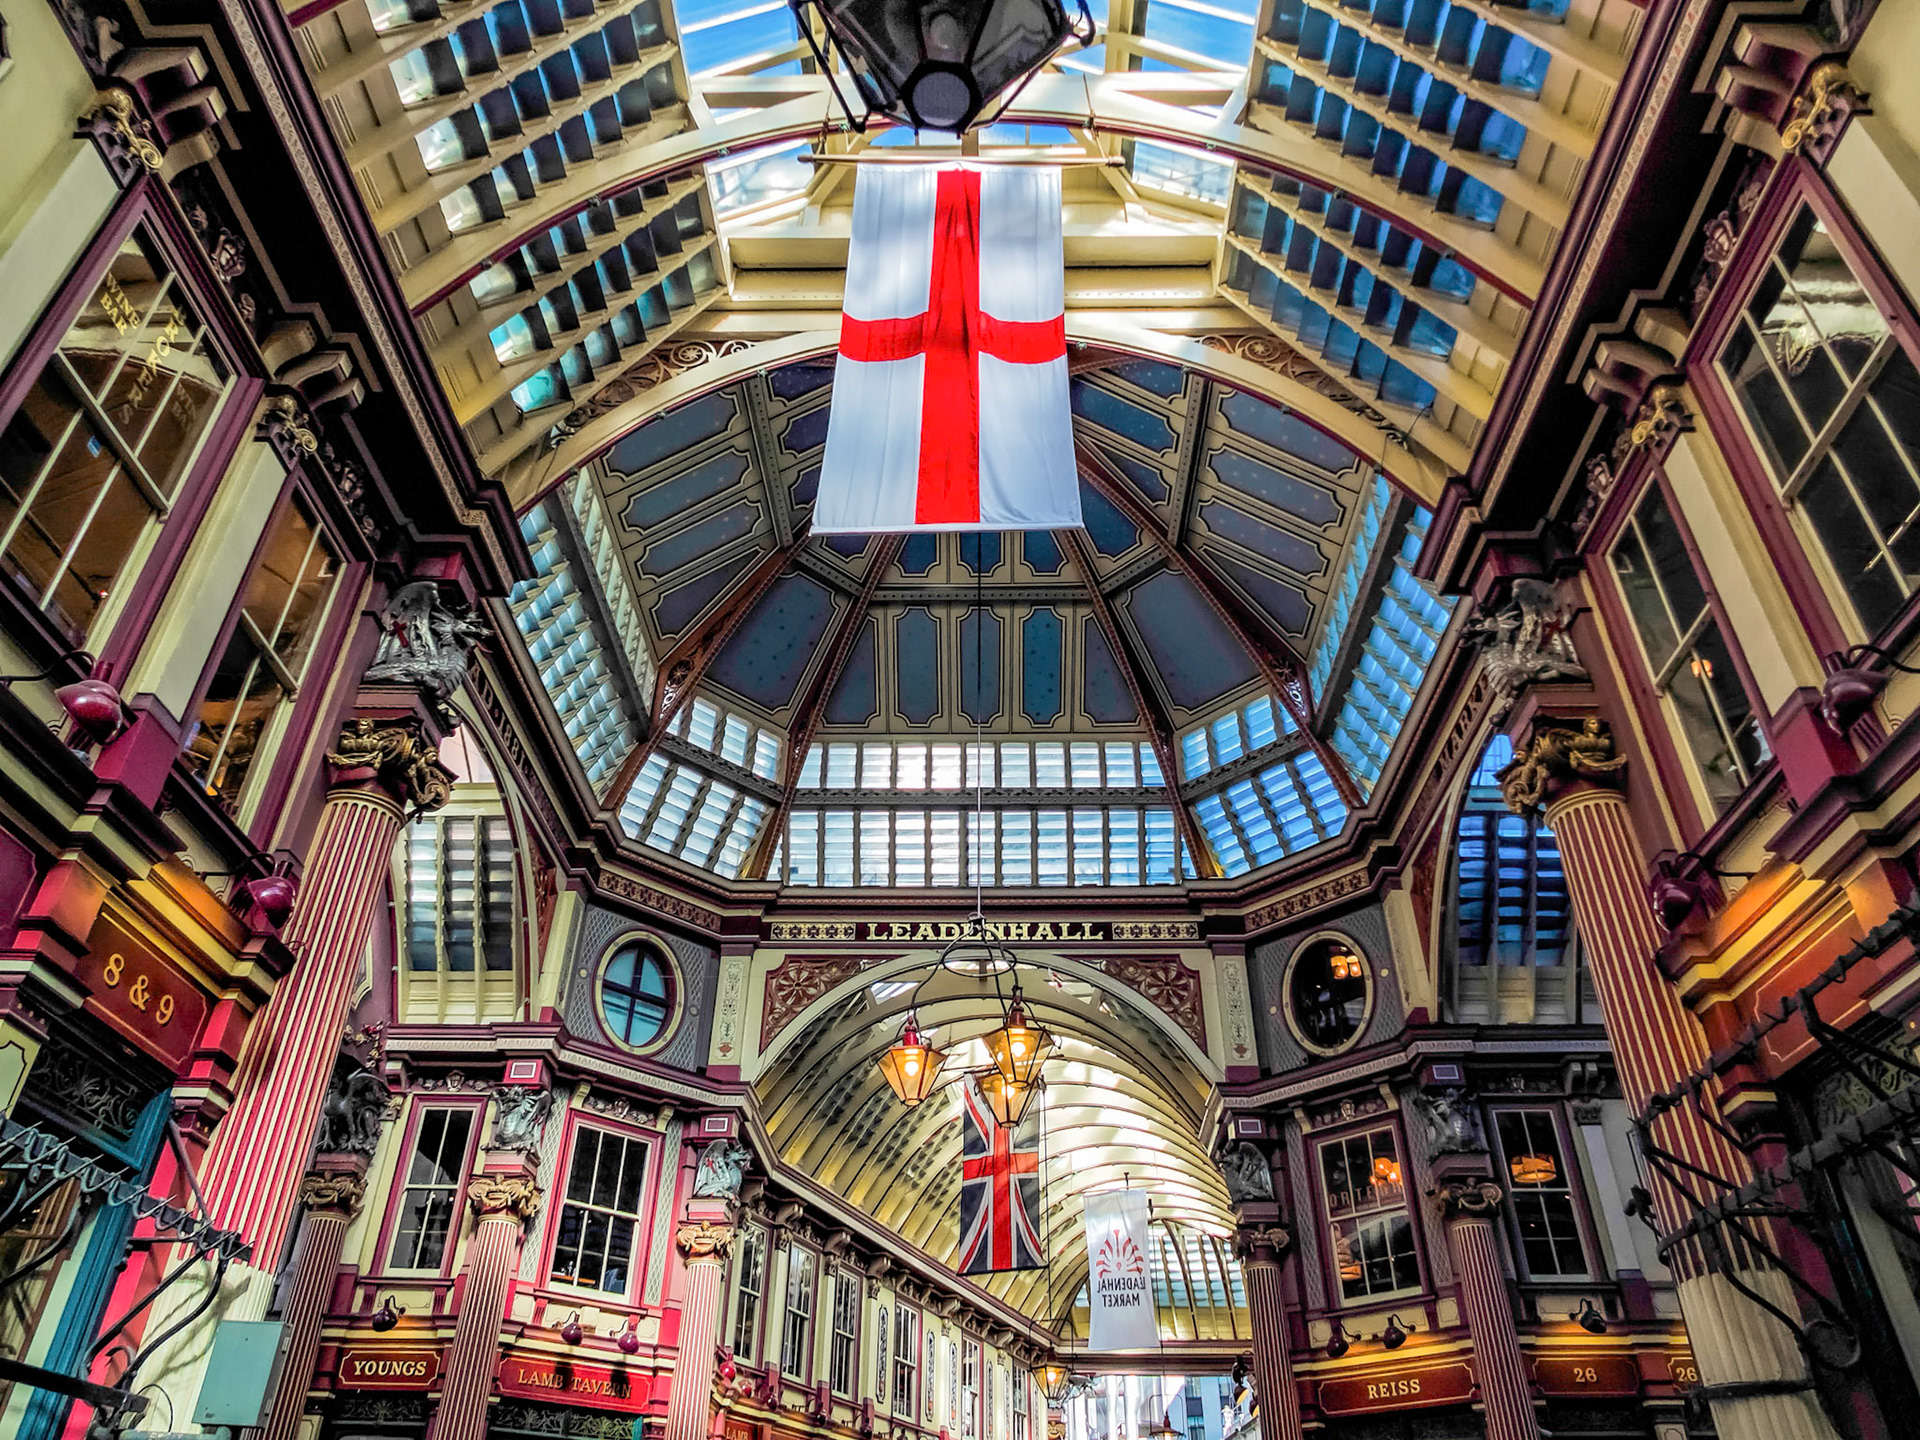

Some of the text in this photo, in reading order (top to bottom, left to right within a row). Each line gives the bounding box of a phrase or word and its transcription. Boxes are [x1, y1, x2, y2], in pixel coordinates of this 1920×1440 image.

[106, 271, 141, 329] WINE
[101, 292, 127, 336] BAR
[866, 923, 1104, 941] LEADENHALL
[103, 953, 174, 1024] 8 & 9
[354, 1360, 427, 1376] YOUNGS
[1573, 1367, 1597, 1382] 26
[1676, 1367, 1698, 1382] 26
[518, 1368, 632, 1399] LAMB TAVERN
[1367, 1379, 1420, 1399] REISS
